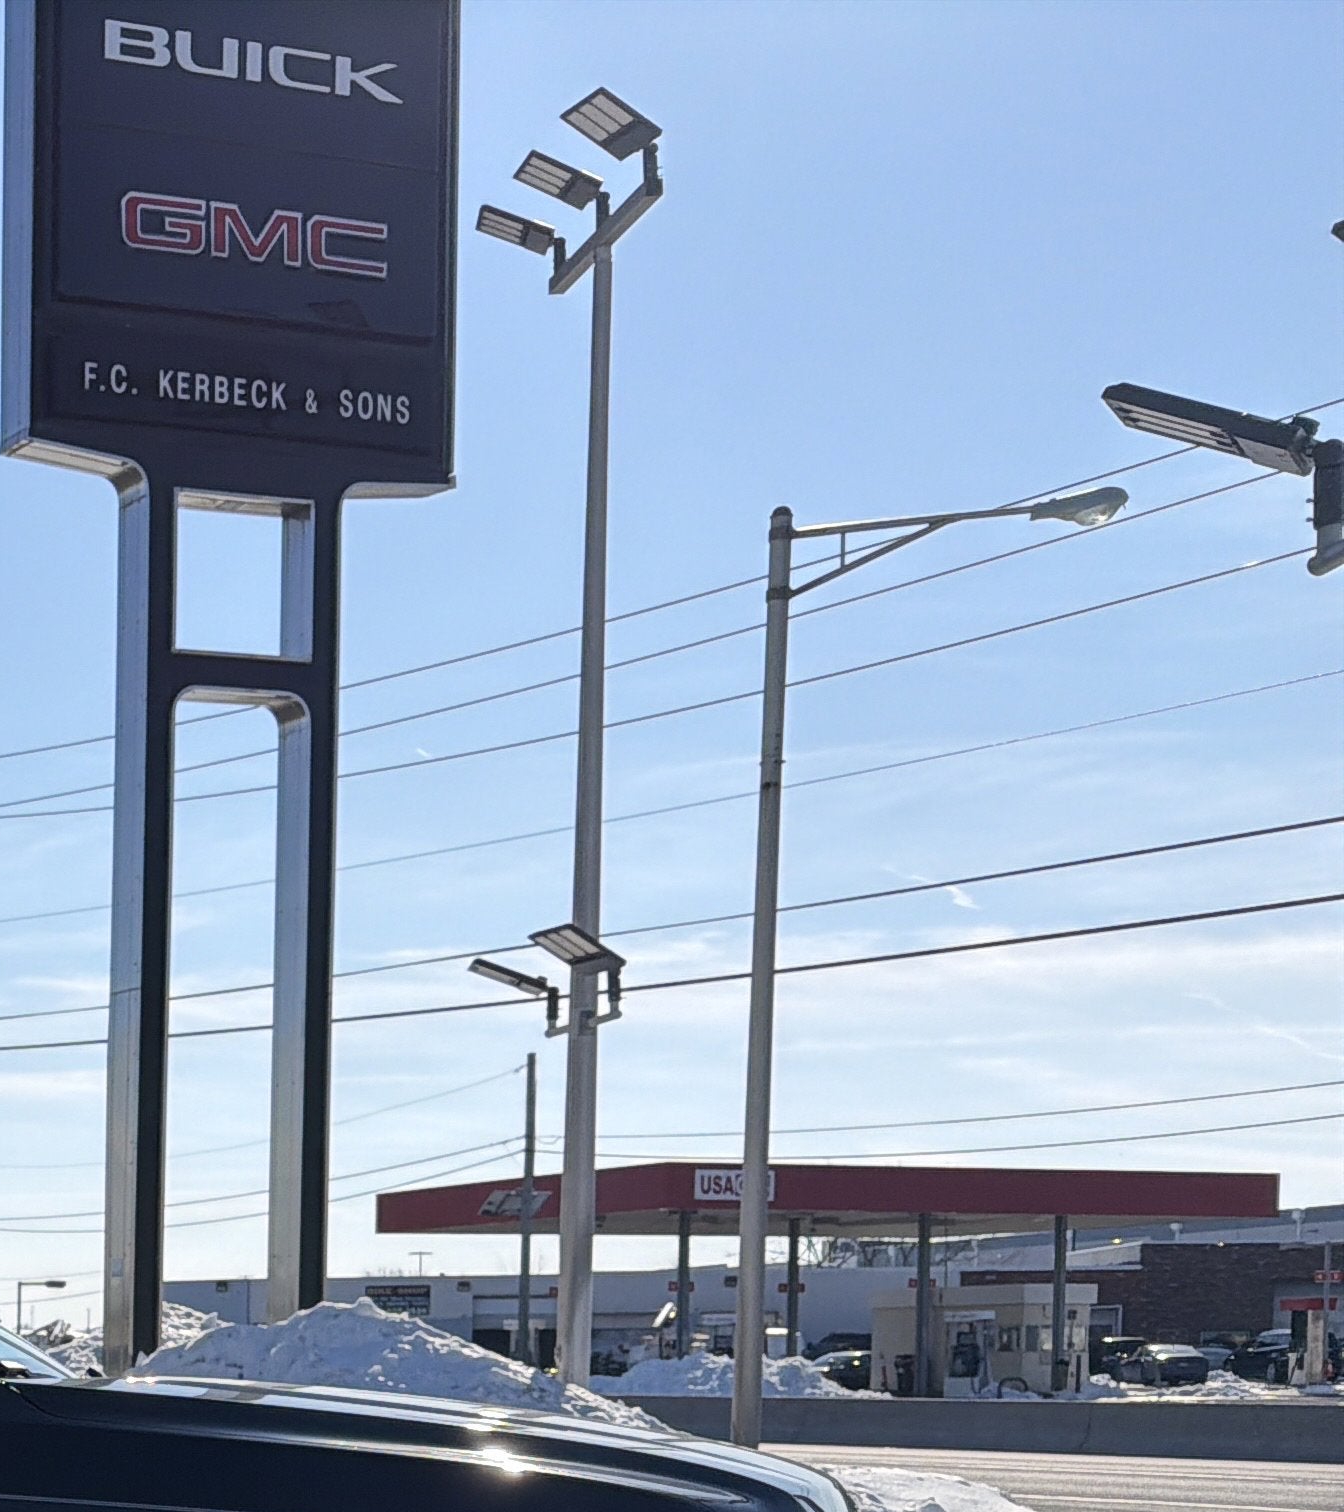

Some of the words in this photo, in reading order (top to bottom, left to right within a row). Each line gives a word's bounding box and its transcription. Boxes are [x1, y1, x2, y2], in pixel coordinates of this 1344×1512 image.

[104, 18, 404, 104] BUICK
[120, 190, 388, 279] GMC
[83, 361, 139, 395] F.C.
[158, 368, 288, 411] KERBECK
[304, 388, 319, 414] &
[339, 388, 411, 425] SONS
[700, 1173, 734, 1196] USA
